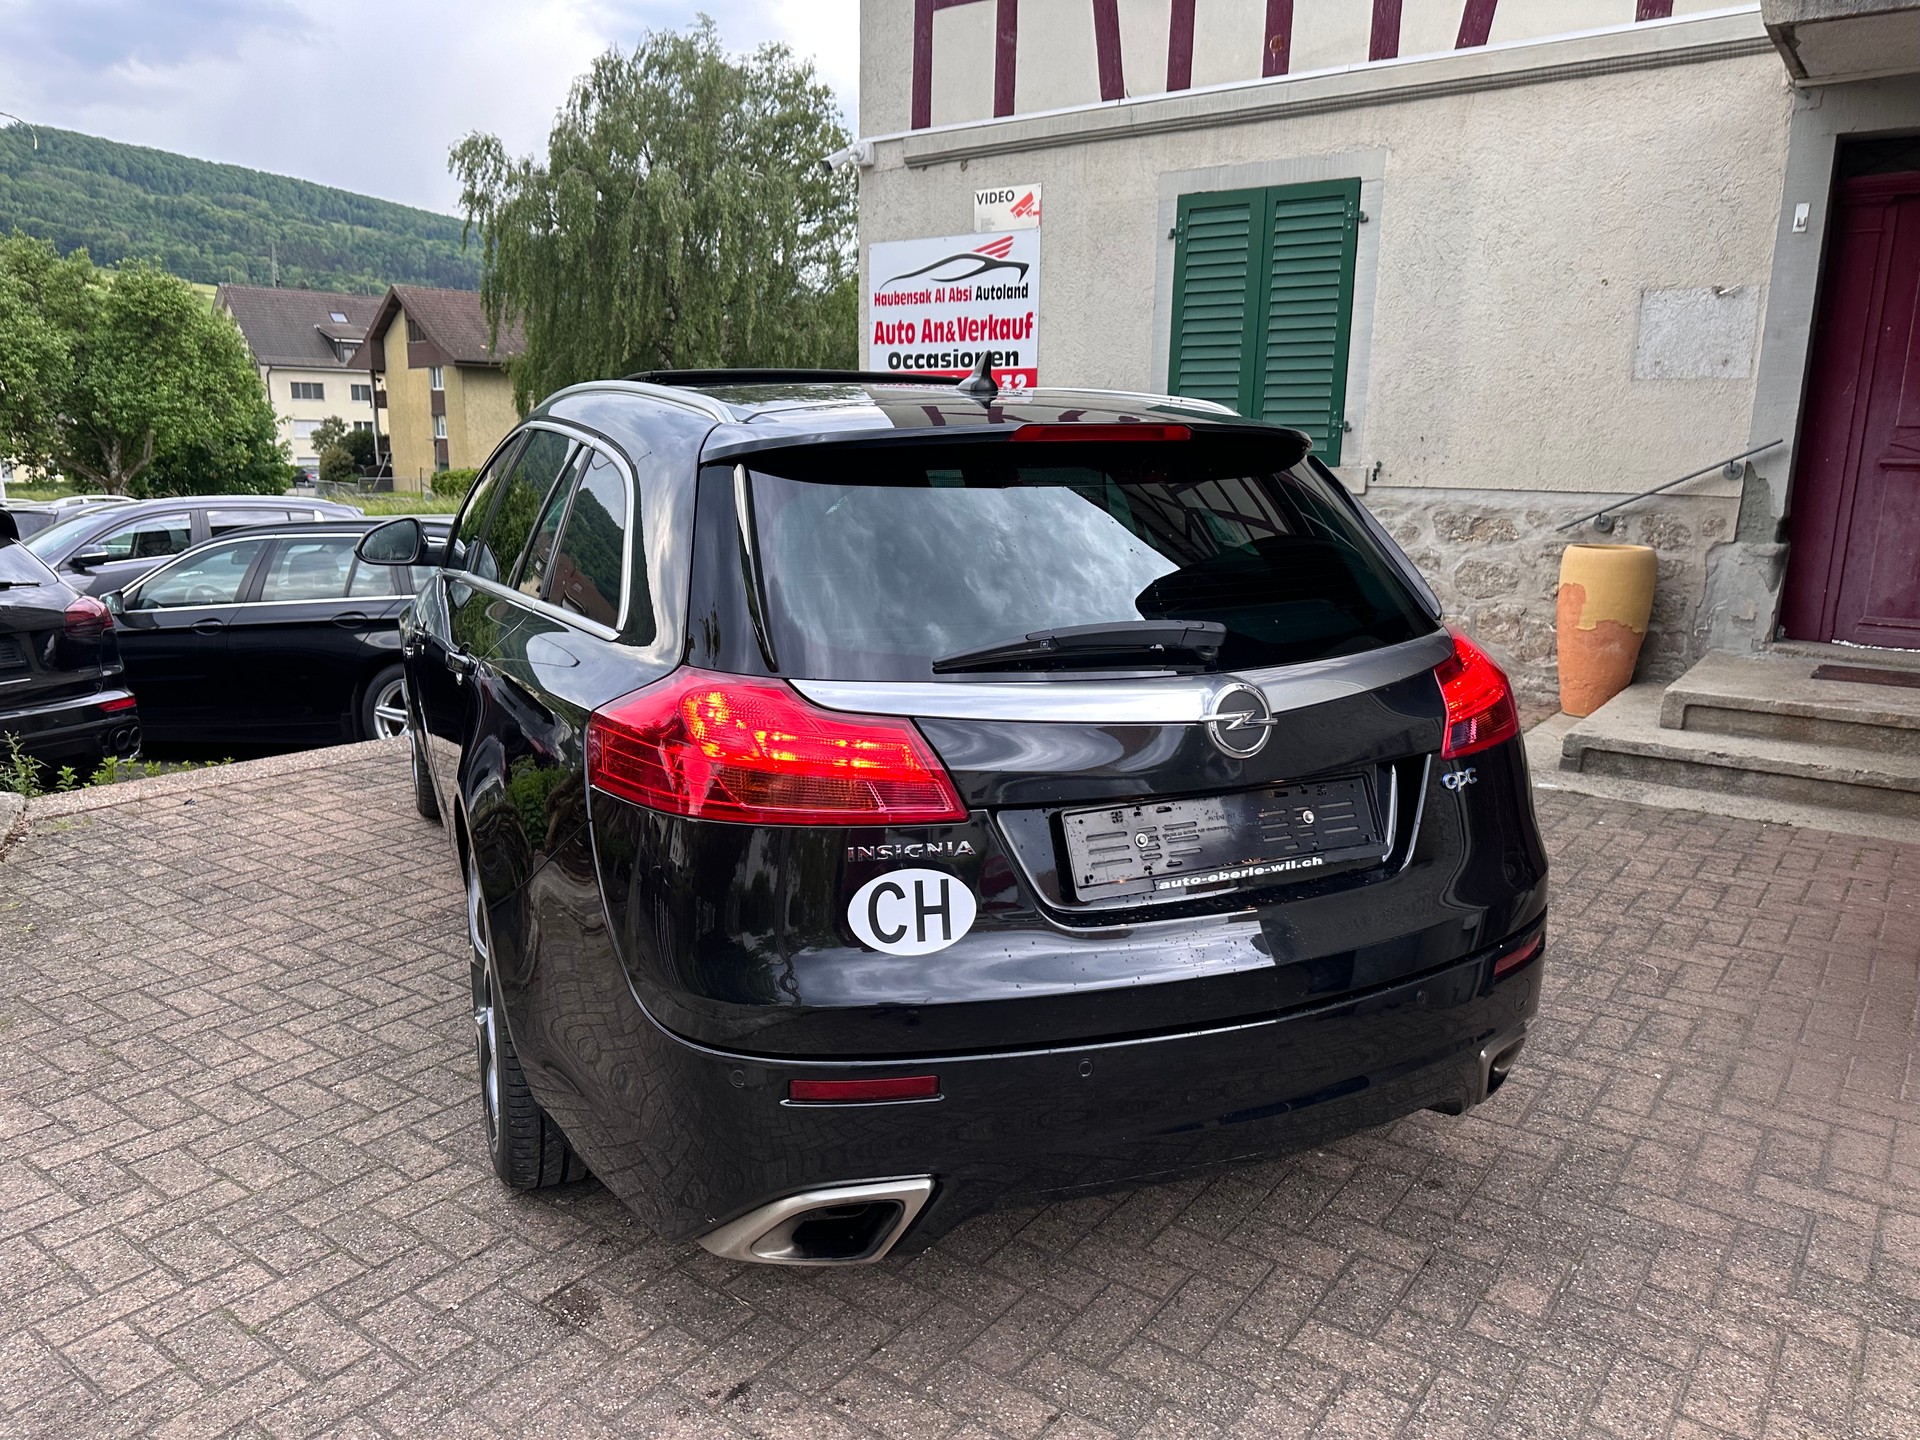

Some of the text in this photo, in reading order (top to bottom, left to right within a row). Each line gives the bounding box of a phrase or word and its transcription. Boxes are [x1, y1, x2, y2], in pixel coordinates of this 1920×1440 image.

[976, 189, 1015, 205] VIDEO
[874, 283, 1029, 307] Haubensak Al Absi Autoland
[873, 311, 1034, 345] Auto An&Verkauf
[847, 840, 977, 862] INSIGNIA
[1158, 856, 1323, 890] auto-eberle-wil.ch
[868, 878, 952, 945] CH
